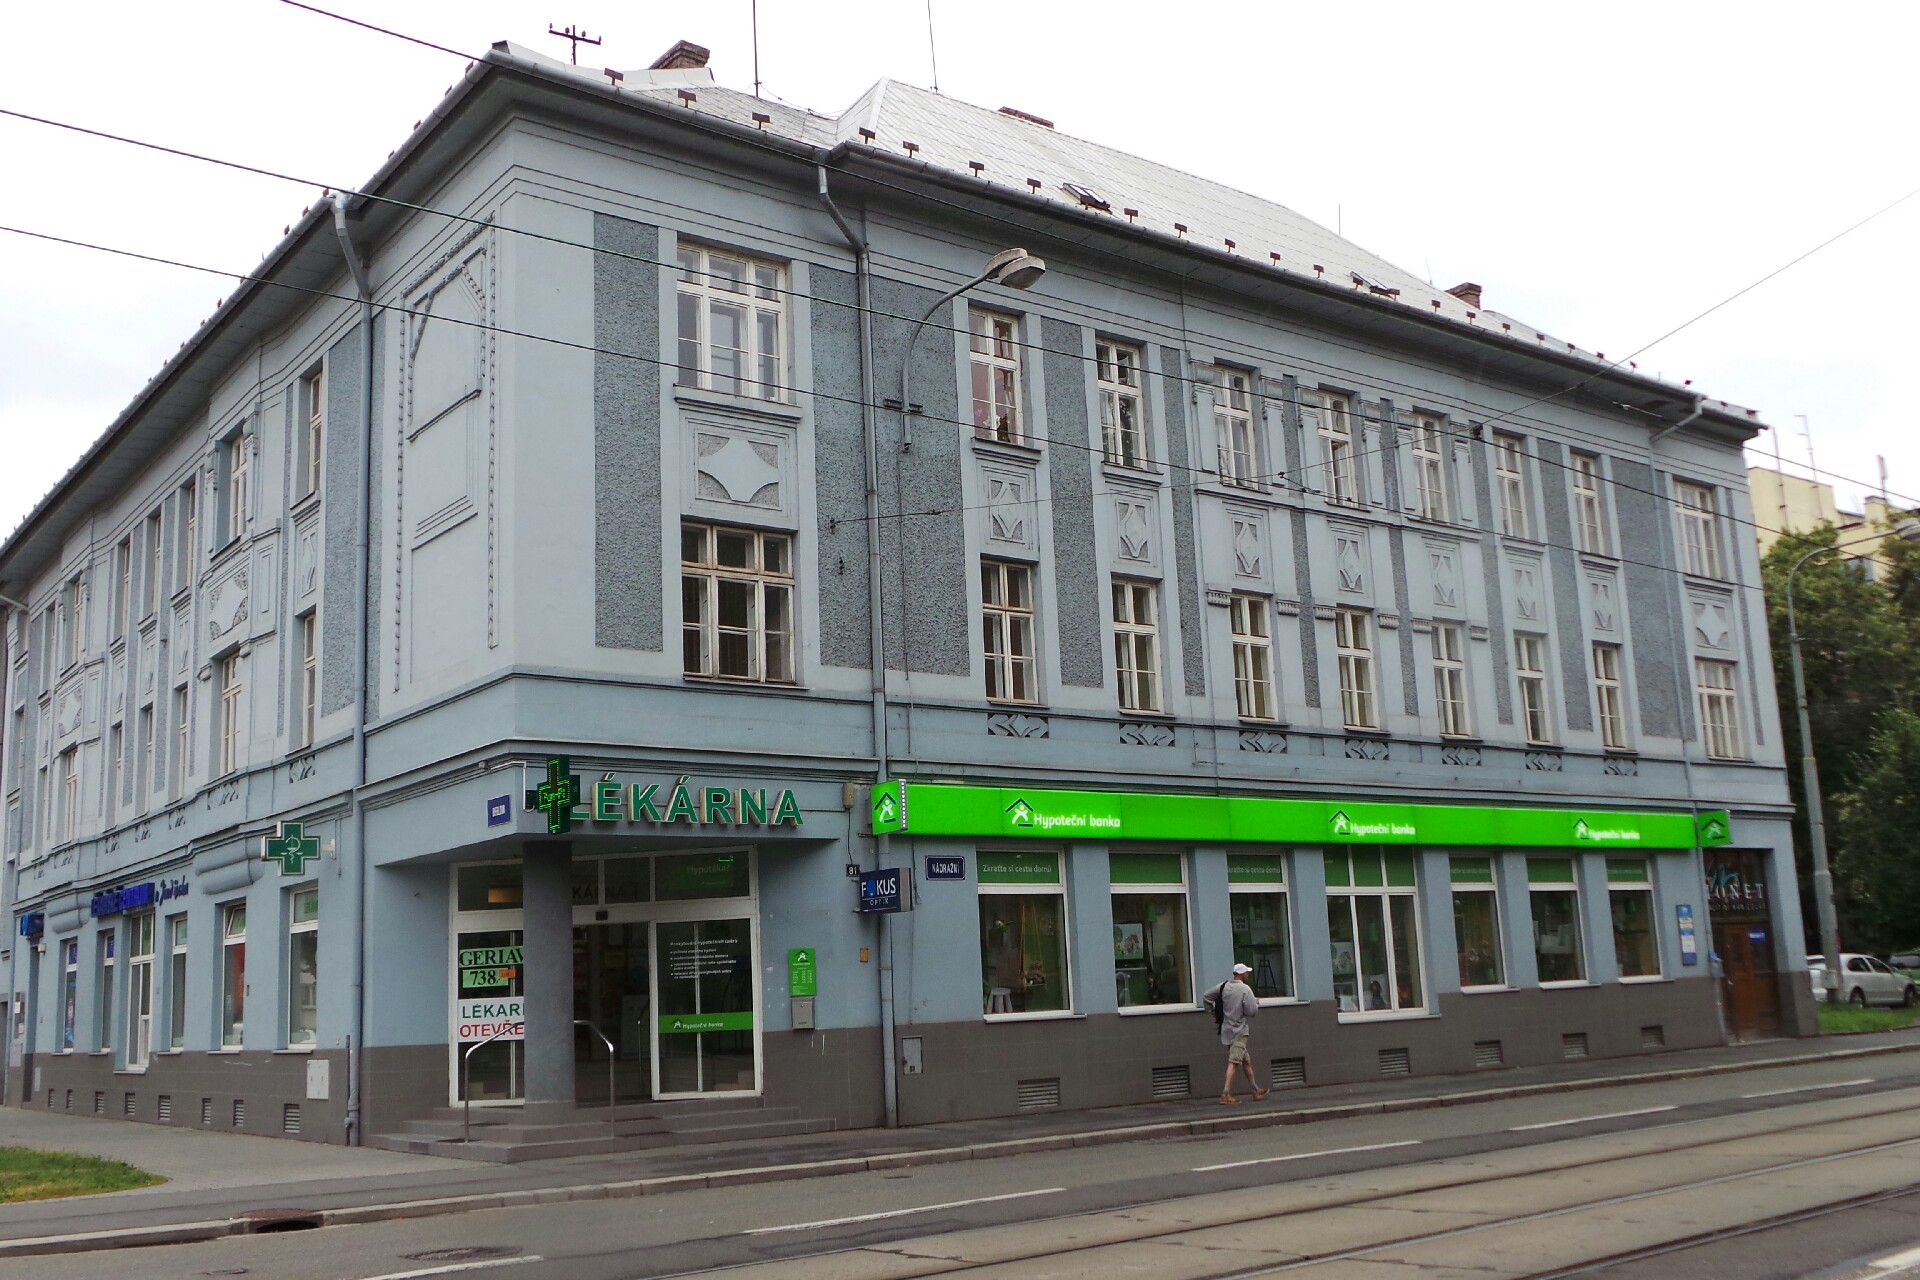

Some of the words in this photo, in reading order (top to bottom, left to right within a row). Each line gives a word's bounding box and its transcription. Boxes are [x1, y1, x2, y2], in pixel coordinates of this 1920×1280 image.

[1034, 813, 1086, 829] Hypoteční
[1090, 814, 1121, 828] banka
[1350, 823, 1389, 836] Hypoteční
[1391, 823, 1416, 835] banka
[848, 866, 857, 875] 81
[1008, 865, 1014, 873] si
[1033, 864, 1052, 873] domů
[861, 878, 897, 897] FOKUS
